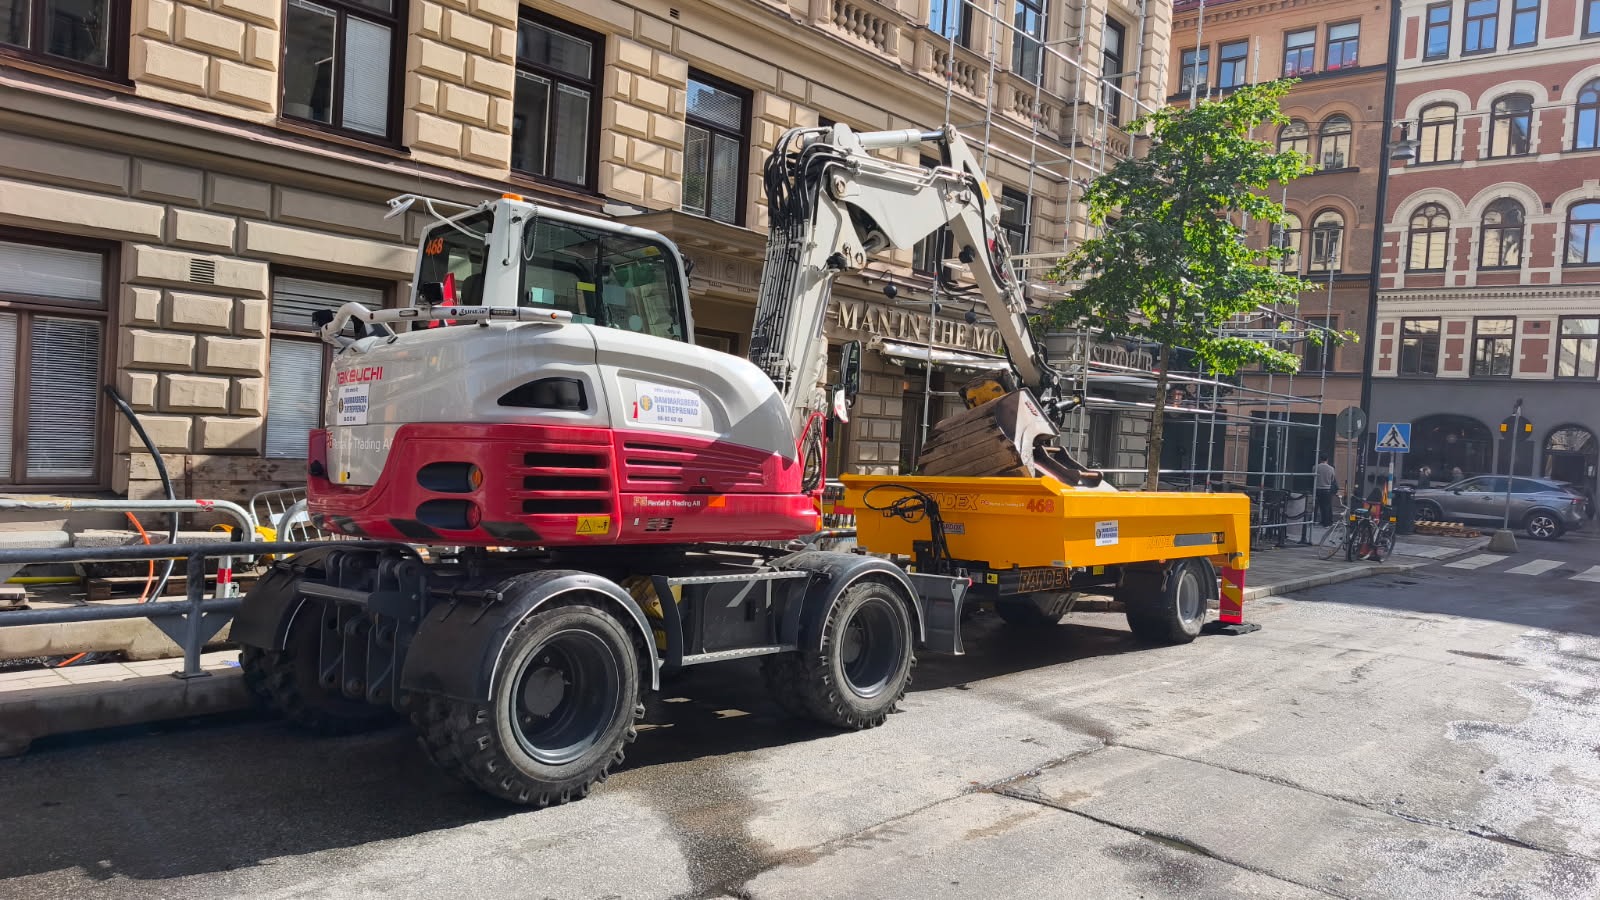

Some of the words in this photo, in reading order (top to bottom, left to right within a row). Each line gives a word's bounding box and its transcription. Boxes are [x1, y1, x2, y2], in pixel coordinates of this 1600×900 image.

[425, 237, 443, 256] 468
[838, 302, 893, 337] MAN
[898, 313, 920, 341] IN
[927, 318, 967, 347] THE
[656, 404, 698, 416] ENTREPRENAD
[353, 439, 381, 452] Trading
[672, 500, 692, 508] Trading
[1026, 498, 1055, 513] 468
